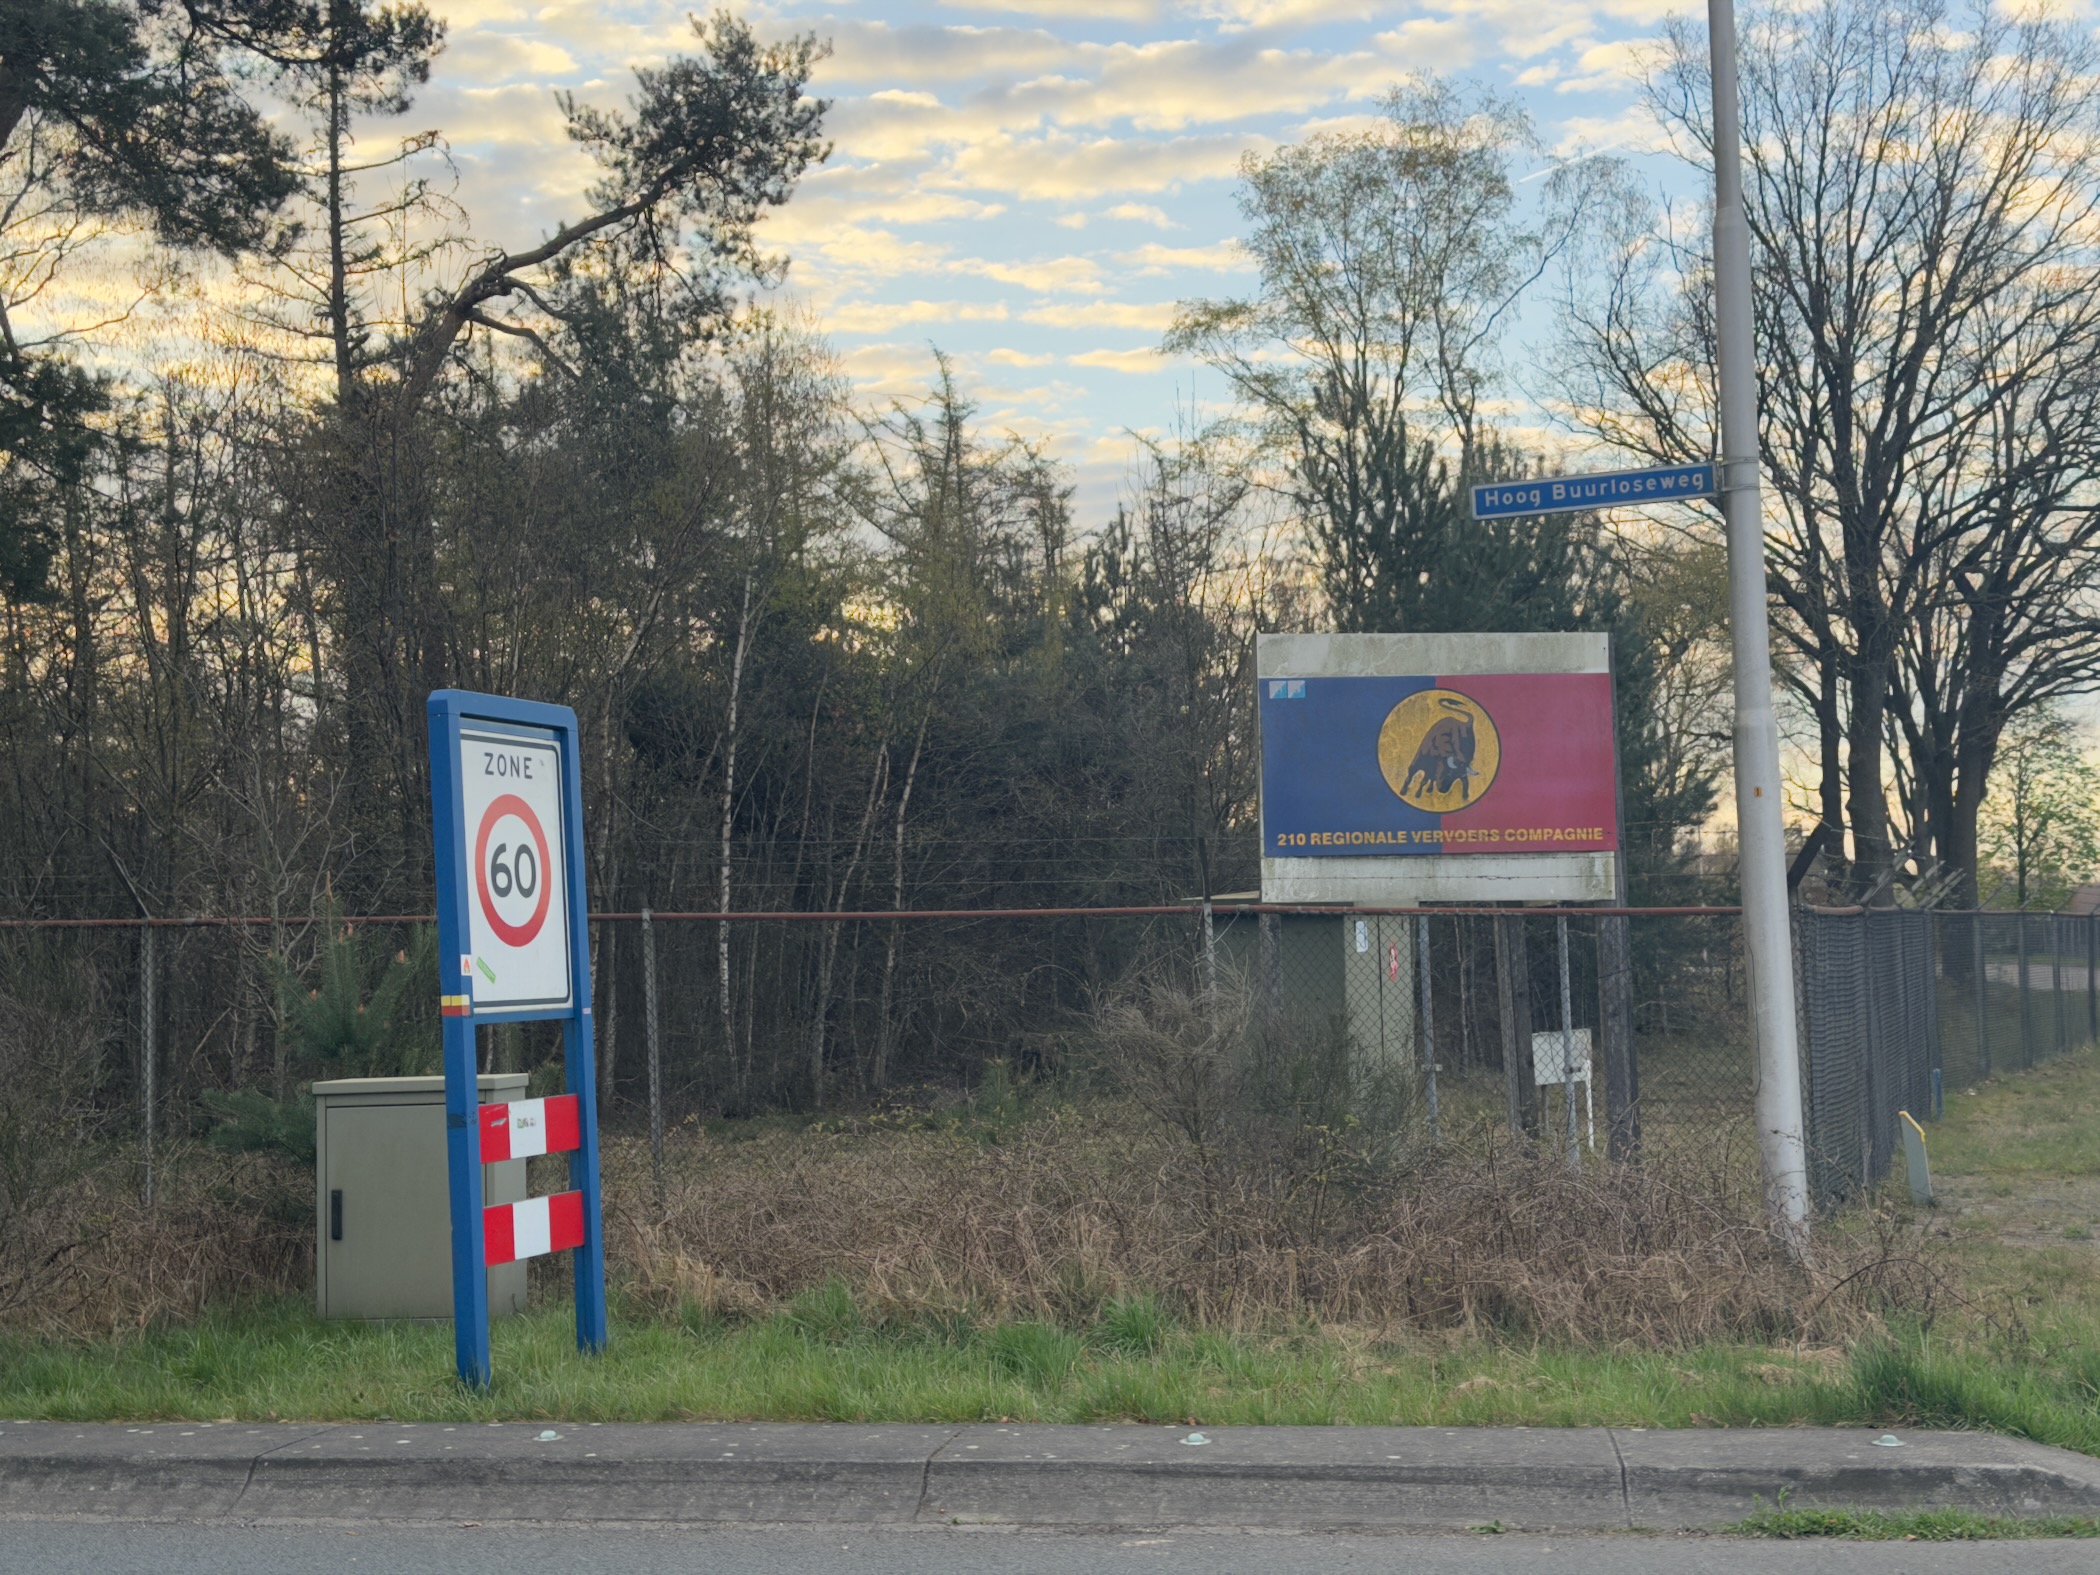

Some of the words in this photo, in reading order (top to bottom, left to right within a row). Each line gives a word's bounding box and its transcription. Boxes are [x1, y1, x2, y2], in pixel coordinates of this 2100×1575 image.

[1484, 489, 1541, 507] Hoog
[1552, 473, 1704, 500] Buurloseweg
[483, 752, 533, 780] ZONE
[1277, 833, 1306, 846] 210
[1310, 831, 1407, 845] REGIONALE
[1411, 830, 1500, 843] VERVOERS
[1504, 827, 1604, 841] COMPAGNIE
[490, 843, 537, 898] 60
